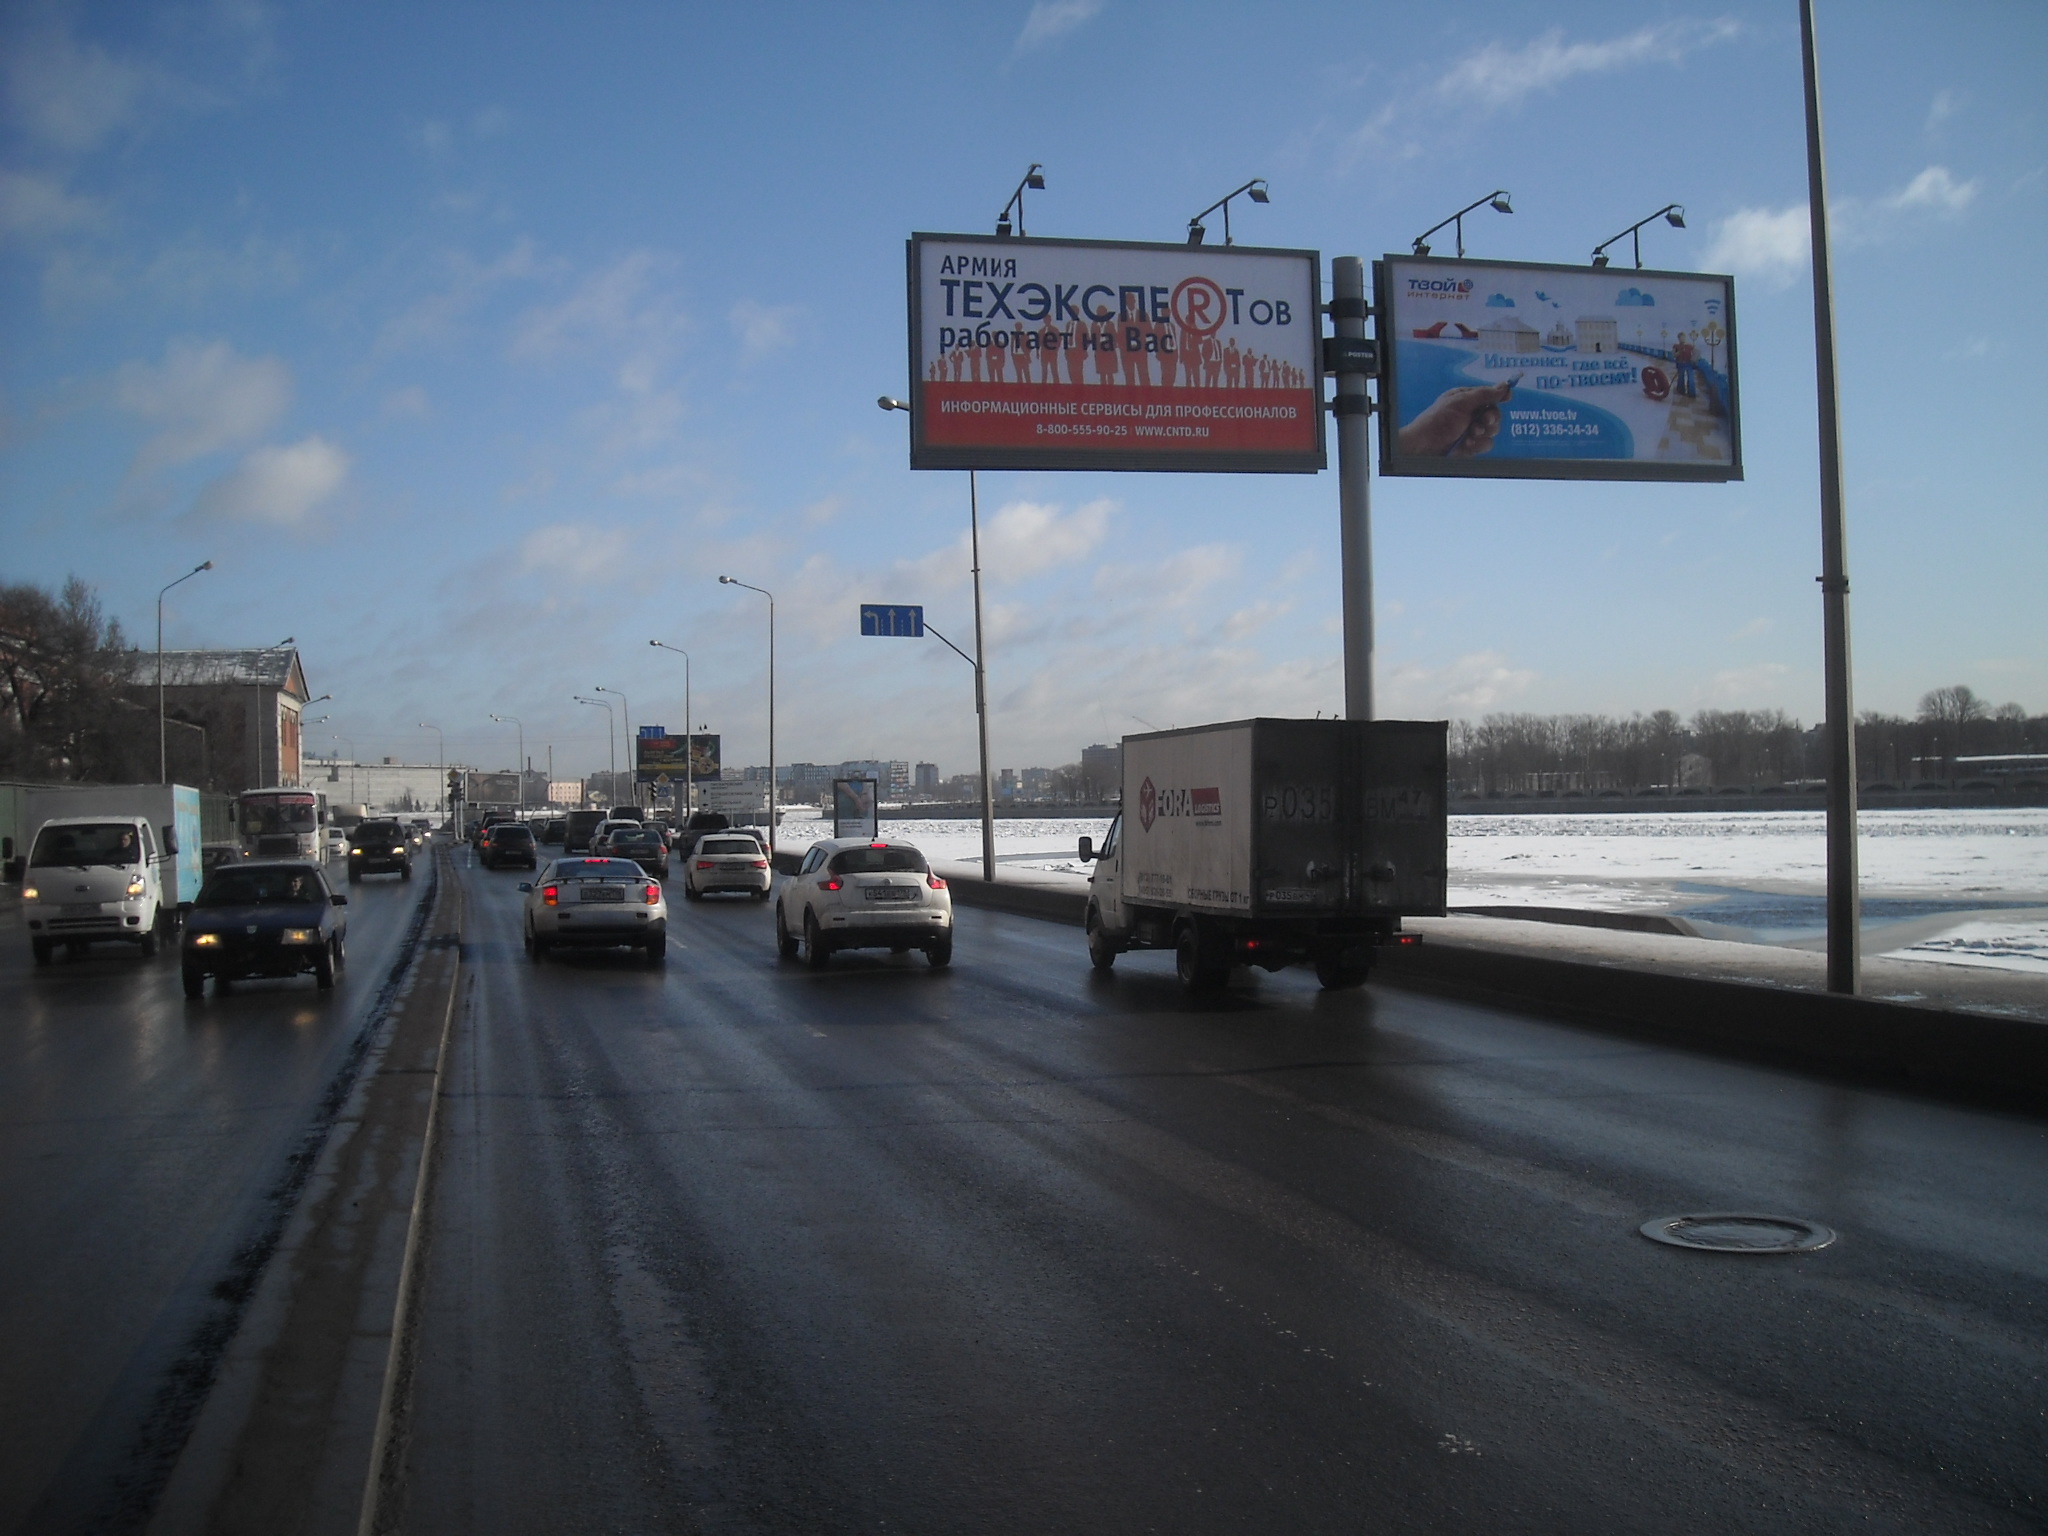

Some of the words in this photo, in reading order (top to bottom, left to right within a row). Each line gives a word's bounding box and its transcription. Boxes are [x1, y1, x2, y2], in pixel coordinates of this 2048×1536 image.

[940, 254, 1017, 279] АРМИЯ
[939, 321, 1072, 354] работает
[1082, 332, 1115, 352] на
[1125, 327, 1175, 354] Вас
[1572, 360, 1599, 371] где
[1604, 357, 1629, 370] всё
[941, 400, 1078, 416] ИНФОРМАЦИОННЫЕ
[1081, 402, 1143, 417] СЕРВИСЫ
[1145, 404, 1172, 419] ДЛЯ
[1175, 405, 1298, 419] ПРОФЕССИОНАЛОВ
[1036, 423, 1128, 436] 8-800-555-90-25
[1135, 425, 1210, 437] WWW.CNTD.RU
[1511, 424, 1540, 437] (812)
[1543, 424, 1599, 436] 336-34-34
